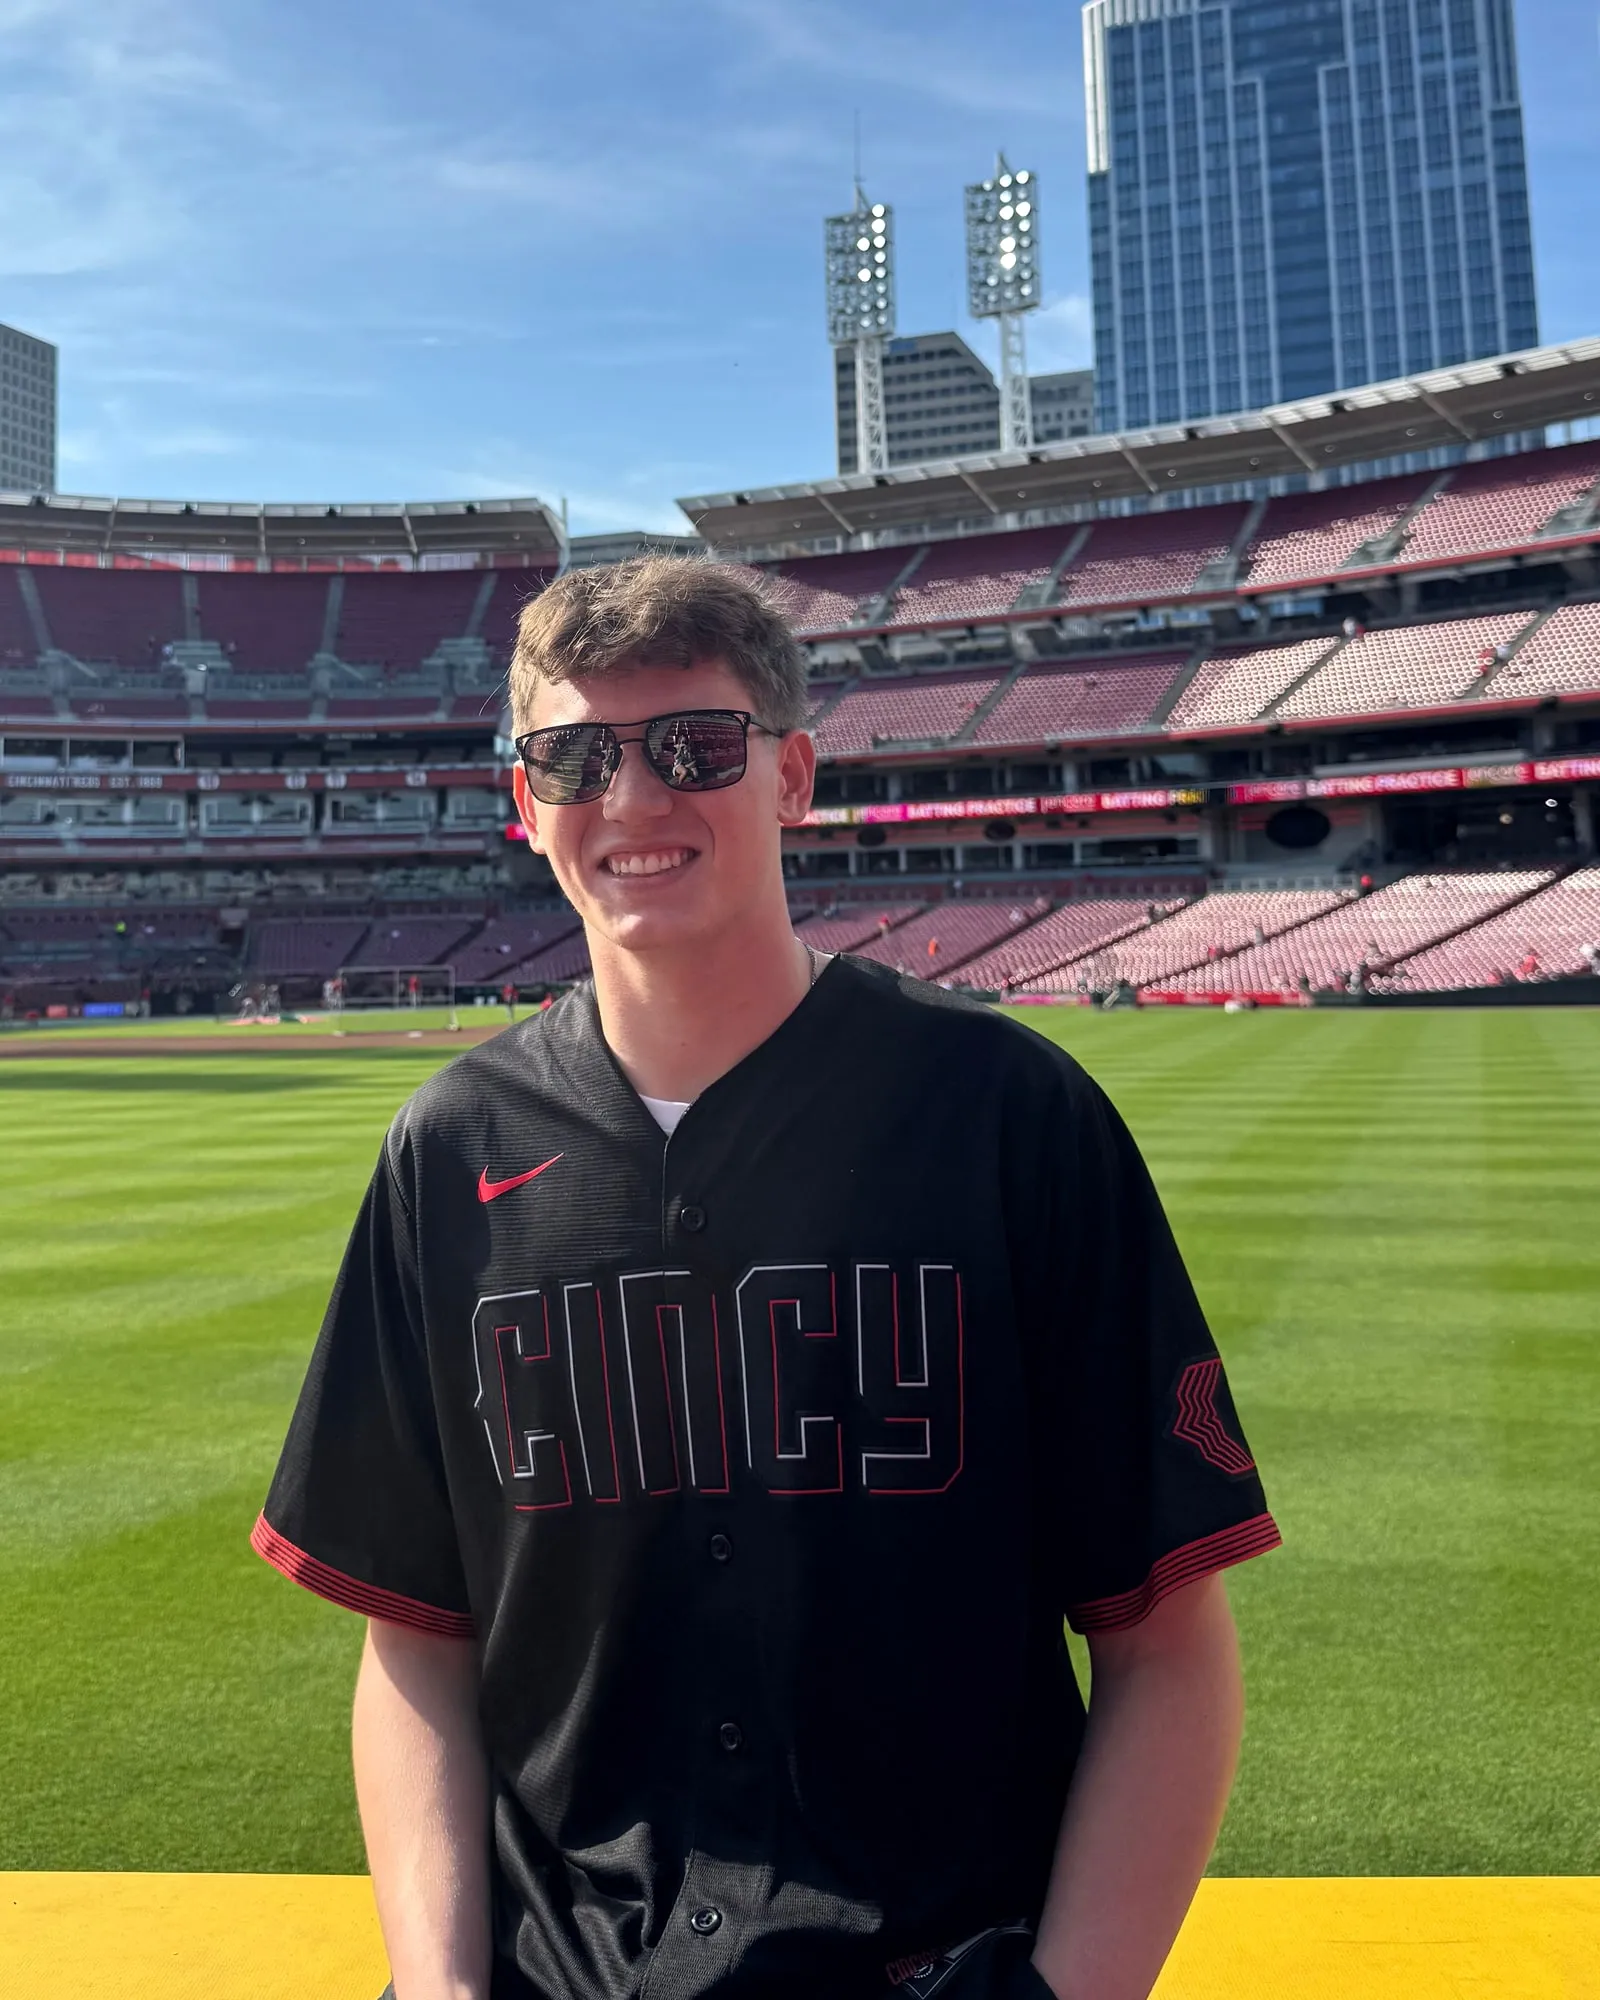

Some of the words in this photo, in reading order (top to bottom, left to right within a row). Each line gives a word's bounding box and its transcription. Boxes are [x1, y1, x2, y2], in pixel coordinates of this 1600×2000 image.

[1306, 776, 1375, 797] BATTING
[1375, 767, 1458, 793] PRACTICE
[908, 800, 965, 819] BATTING
[966, 797, 1036, 816] PRACTICE
[1100, 790, 1168, 809] BATTING
[472, 1263, 964, 1512] CINCY
